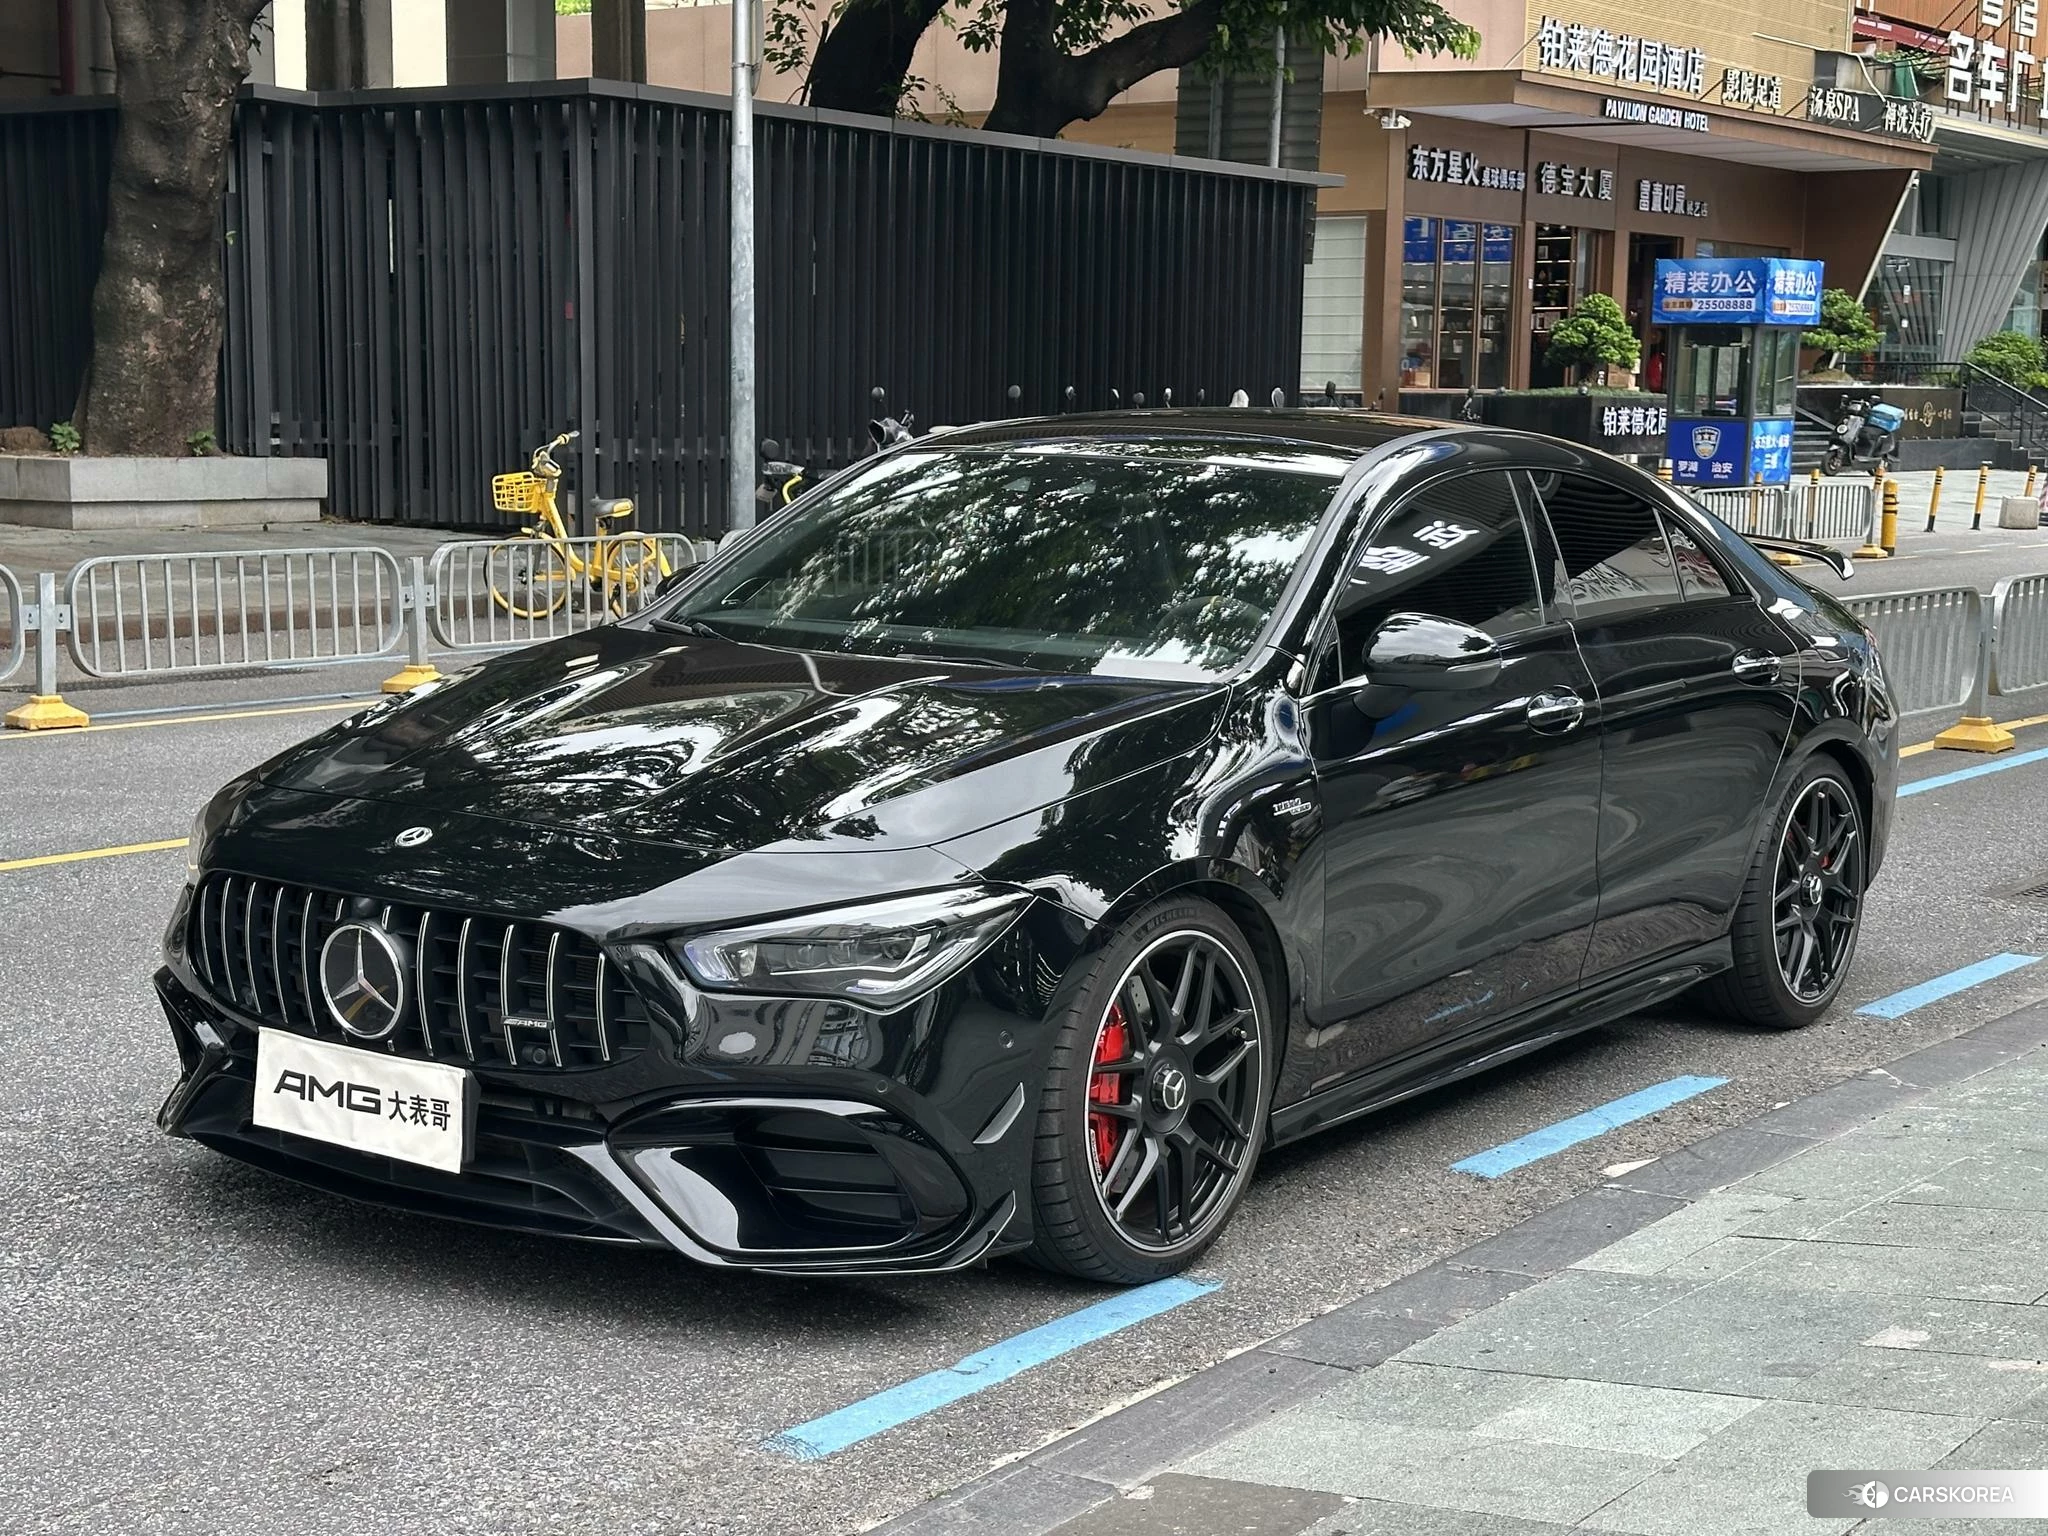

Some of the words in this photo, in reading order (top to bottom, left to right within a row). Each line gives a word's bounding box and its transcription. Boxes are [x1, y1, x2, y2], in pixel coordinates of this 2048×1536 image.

[1539, 16, 1706, 94] 铂莱德花园酒店
[1722, 68, 1782, 109] 影院足道
[1944, 30, 2048, 119] 名车广
[1605, 99, 1647, 122] PAVILION
[1649, 104, 1682, 127] GARDEN
[1684, 111, 1709, 131] HOTEL
[1810, 85, 1860, 122] 汤泉SPA
[1412, 145, 1479, 186] 东方星火
[1541, 162, 1613, 200] 德宝大厦
[1664, 270, 1756, 294] 精装办公
[1774, 269, 1817, 296] 精装办公
[1697, 299, 1753, 310] 25508888
[273, 1069, 381, 1115] AMG
[388, 1090, 451, 1131] 大表哥
